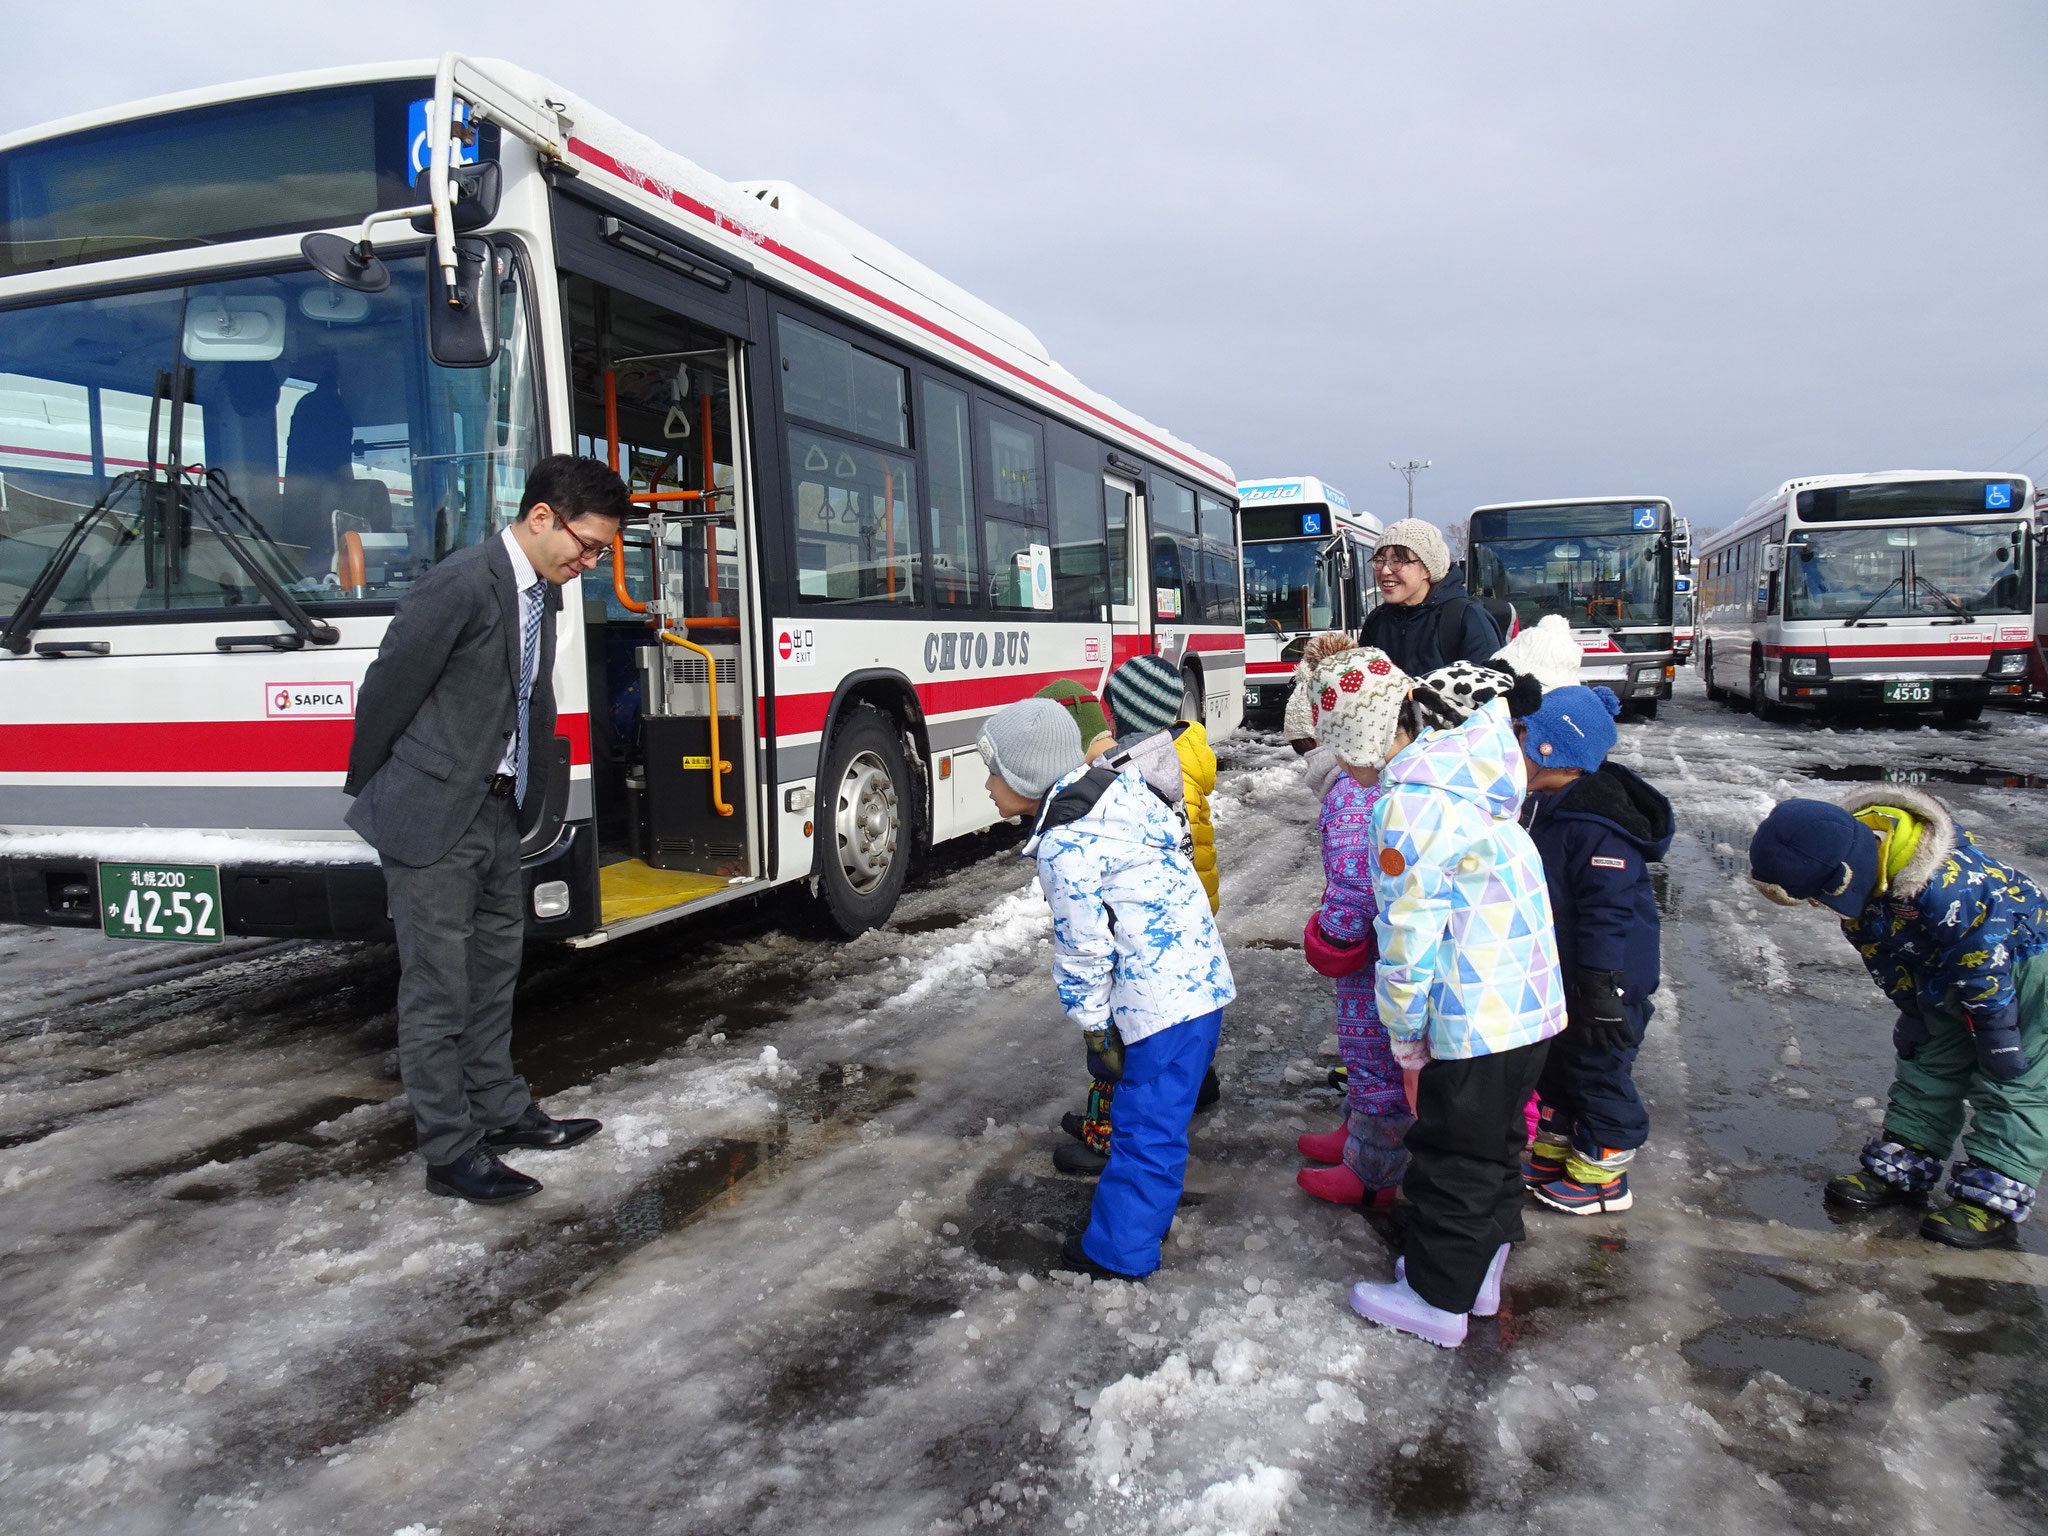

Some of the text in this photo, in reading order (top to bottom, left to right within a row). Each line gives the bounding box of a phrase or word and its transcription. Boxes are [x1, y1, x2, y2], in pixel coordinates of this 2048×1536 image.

[793, 629, 813, 648] 出口
[796, 651, 811, 663] EXIT
[924, 630, 1029, 673] CHUO BUS
[294, 694, 344, 706] SAPICA
[1246, 692, 1259, 704] 35
[1892, 687, 1931, 701] 45-03
[131, 870, 186, 888] 札幌200
[108, 889, 217, 936] か 42-52
